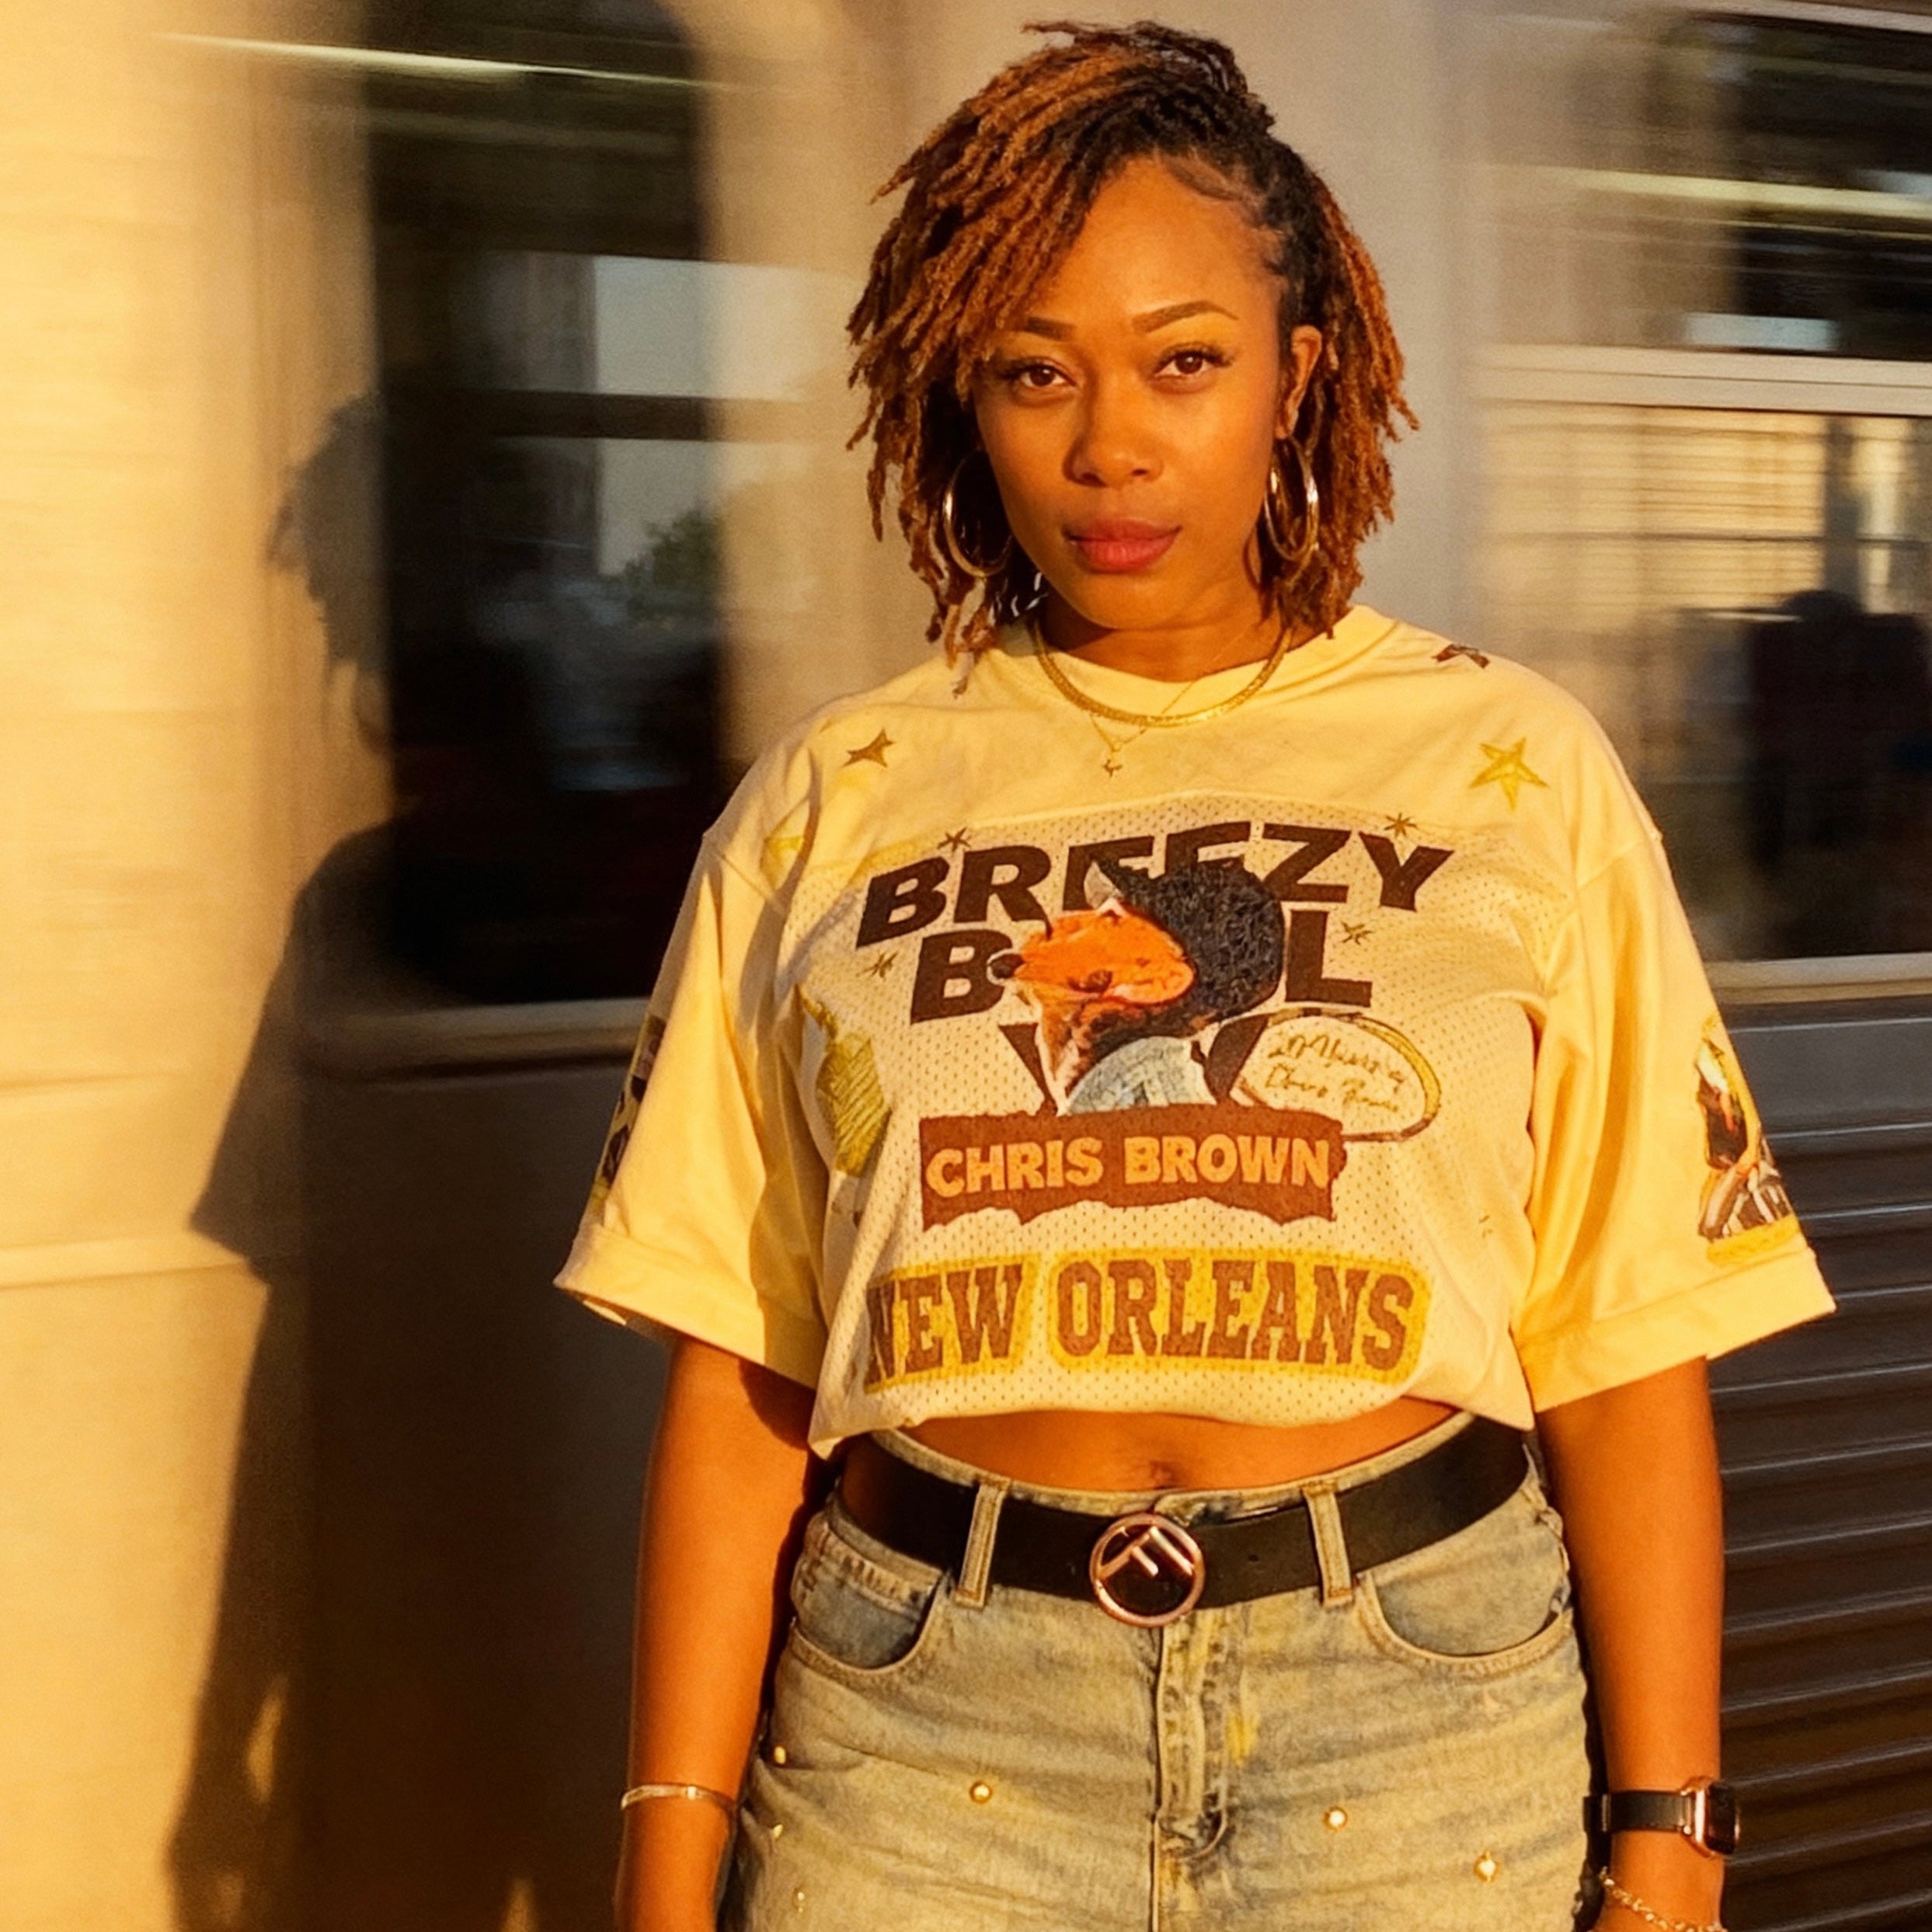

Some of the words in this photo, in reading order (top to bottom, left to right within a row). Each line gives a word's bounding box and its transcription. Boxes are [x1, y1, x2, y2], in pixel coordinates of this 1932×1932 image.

[910, 909, 1373, 1025] BL
[926, 1137, 1103, 1197] CHRIS
[1124, 1133, 1330, 1188] BROWN
[864, 1263, 1023, 1384] NEW
[1057, 1258, 1415, 1370] ORLEANS
